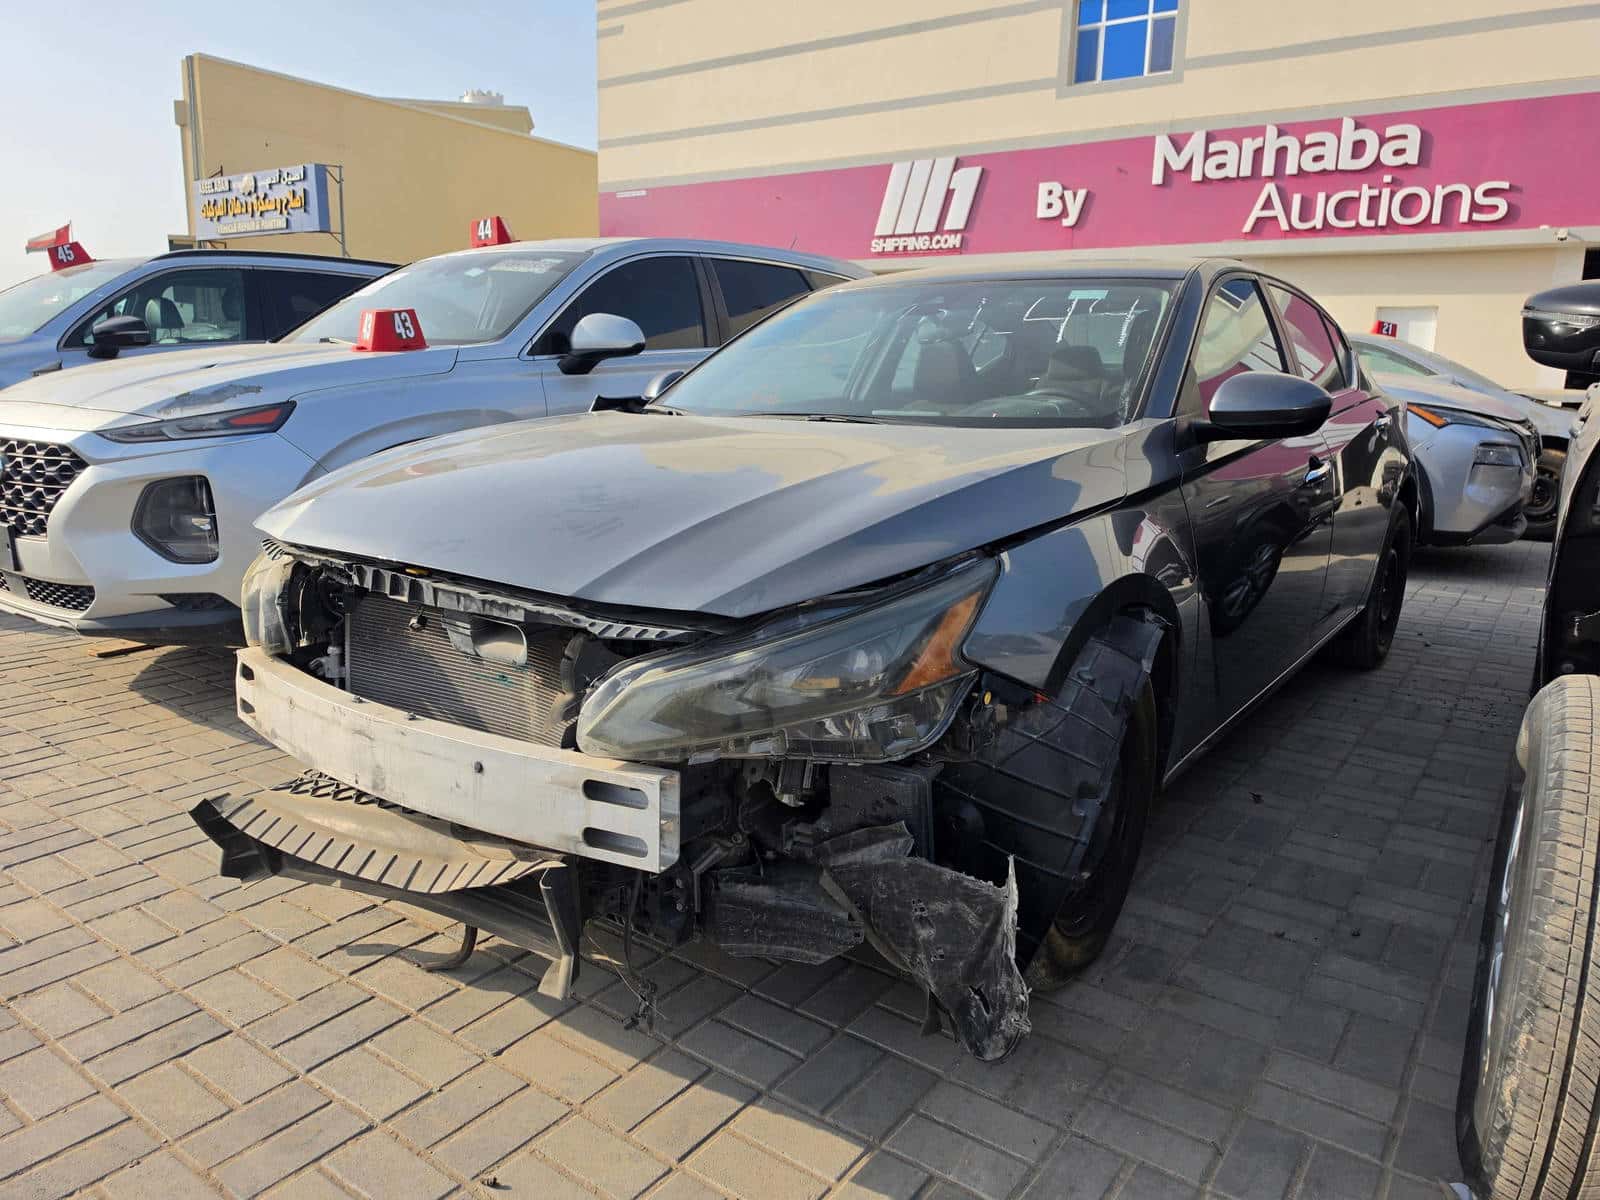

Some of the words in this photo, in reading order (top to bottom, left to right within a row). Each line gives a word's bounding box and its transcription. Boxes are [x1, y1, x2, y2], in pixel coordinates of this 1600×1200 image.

[1152, 117, 1422, 185] Marhaba
[1037, 181, 1088, 227] By
[1241, 174, 1511, 233] Auctions
[477, 218, 493, 240] 44
[57, 244, 75, 262] 45
[871, 234, 962, 253] SHIPPING.COM
[393, 311, 415, 339] 43
[1382, 321, 1393, 335] 21
